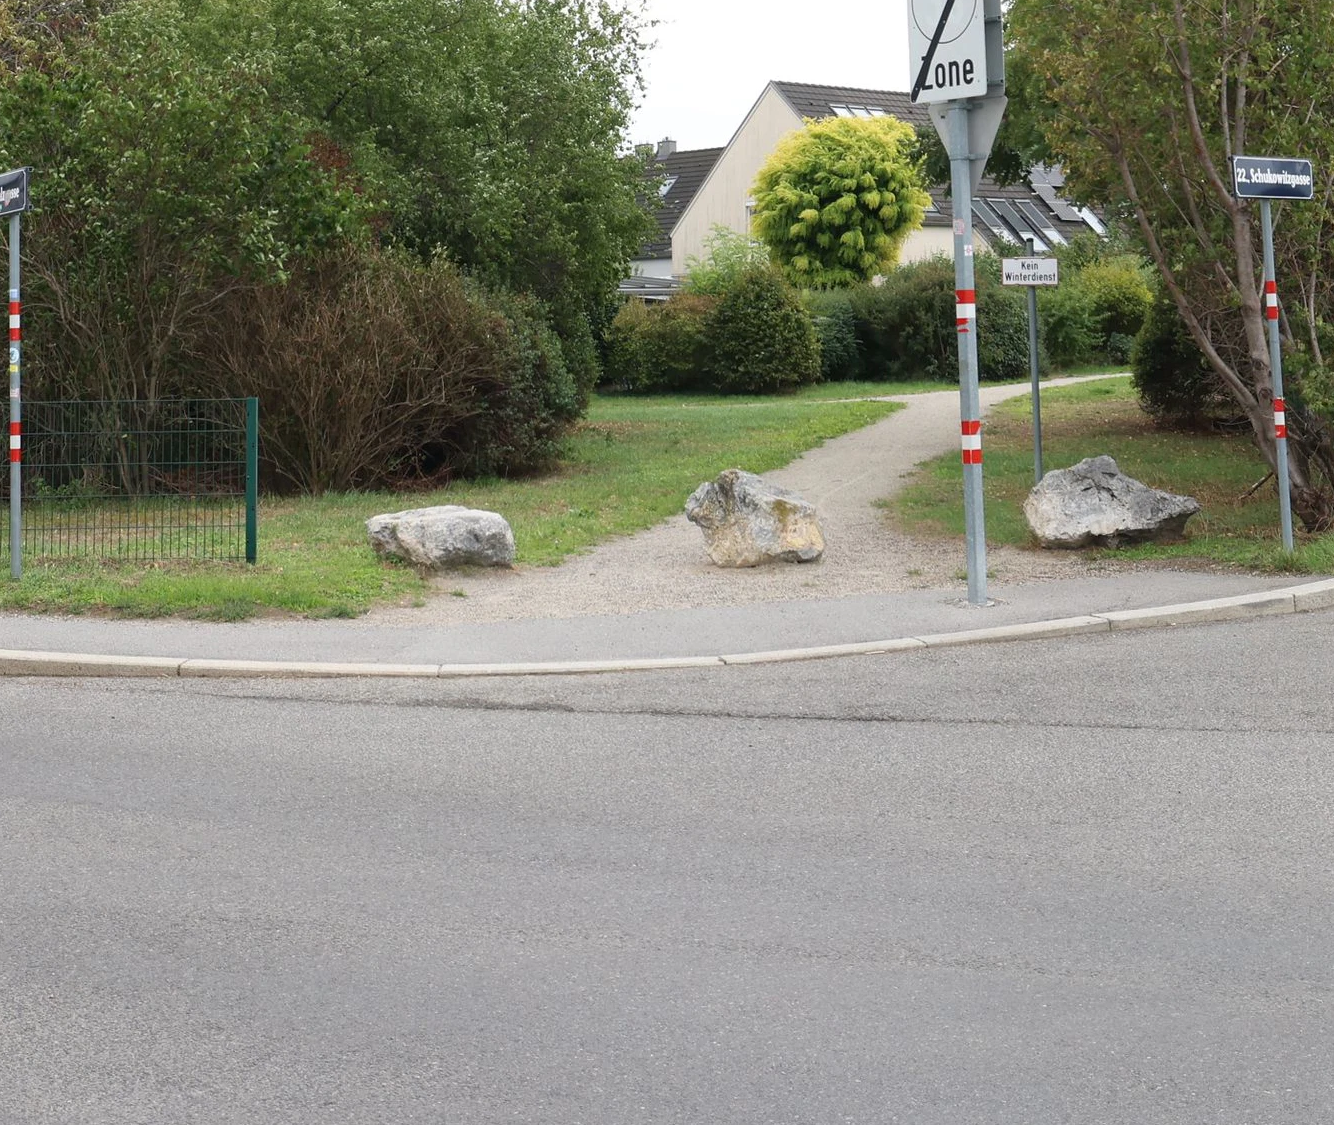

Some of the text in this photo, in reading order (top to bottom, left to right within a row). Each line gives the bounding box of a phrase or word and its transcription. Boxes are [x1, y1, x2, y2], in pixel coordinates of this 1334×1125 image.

[921, 56, 974, 91] Zone
[1250, 167, 1310, 188] Schukowitzgasse
[1021, 261, 1039, 270] Kein
[1005, 272, 1056, 281] Winterdienst
